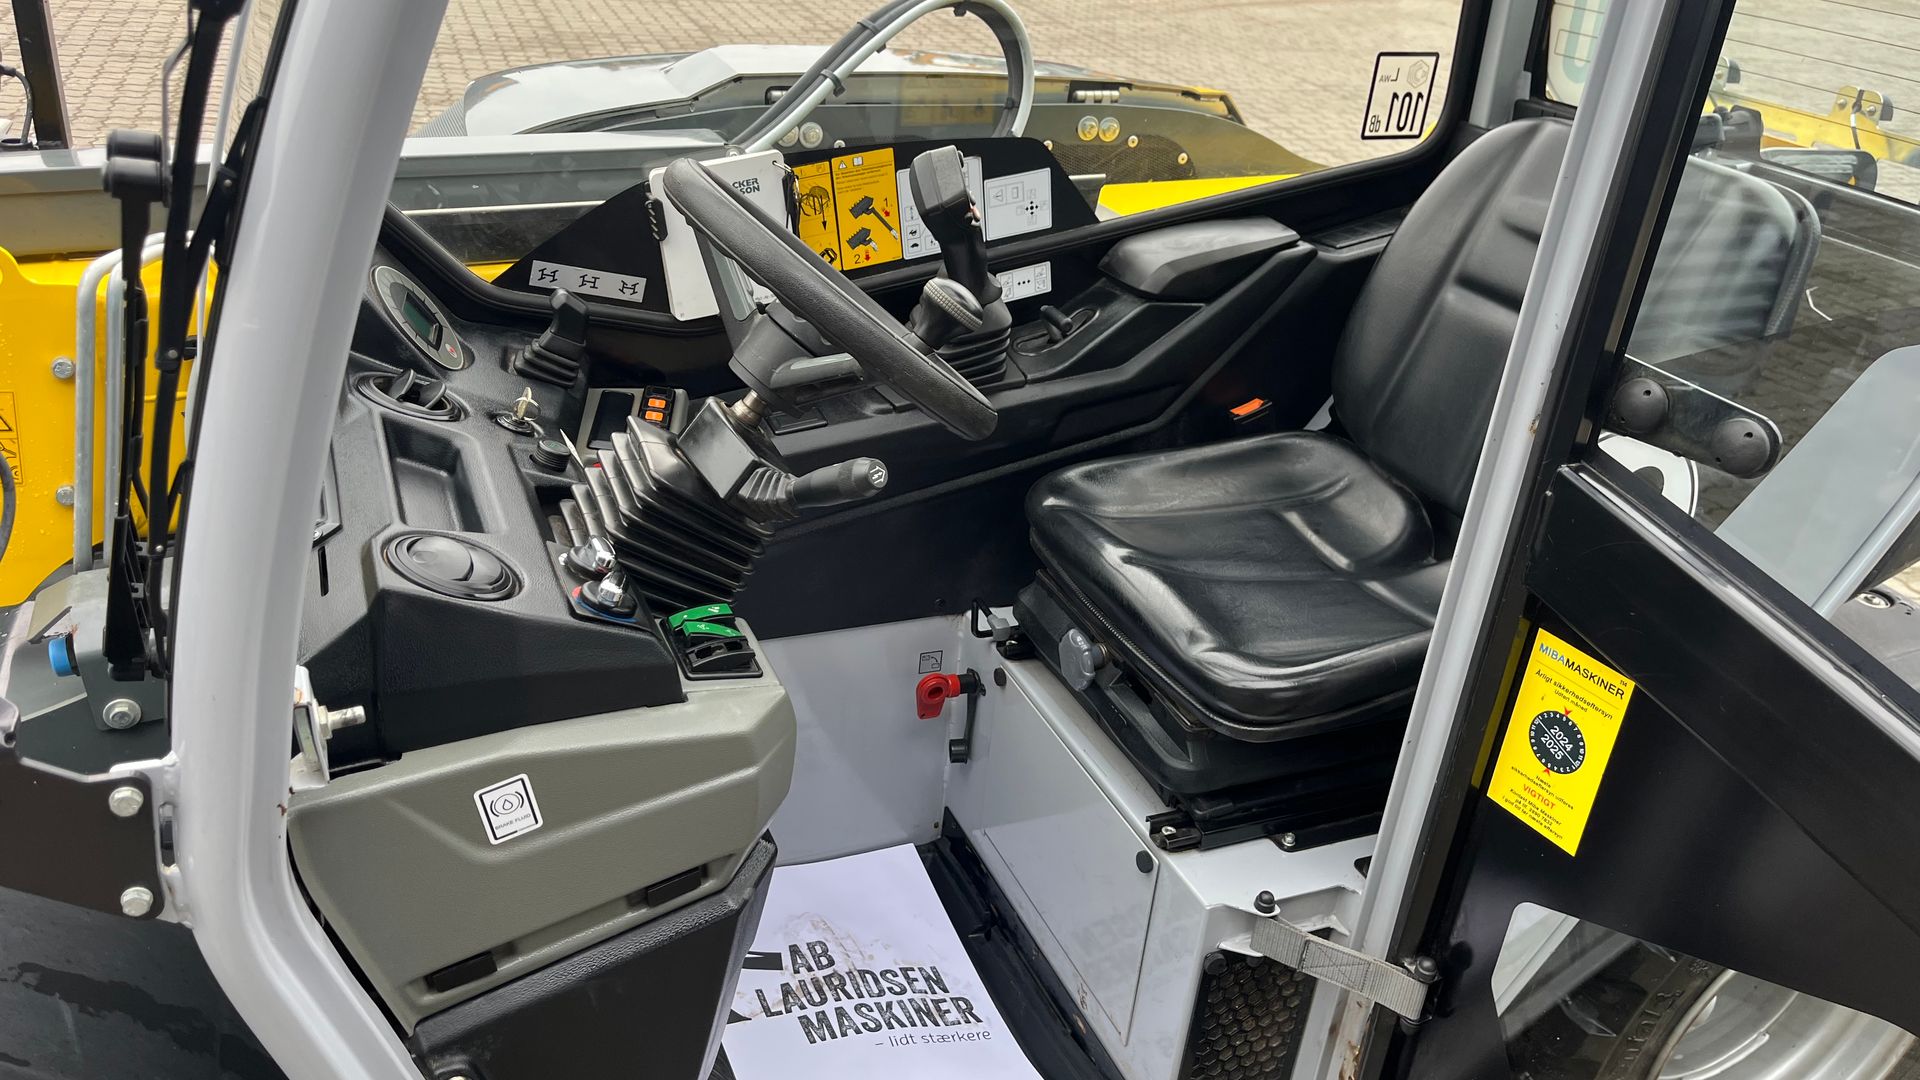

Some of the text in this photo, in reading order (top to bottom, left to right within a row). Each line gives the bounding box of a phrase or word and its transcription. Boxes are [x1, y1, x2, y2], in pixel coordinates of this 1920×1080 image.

[732, 178, 759, 188] CKER
[740, 185, 760, 194] SON
[1540, 643, 1625, 700] MIBAMASKINER
[1536, 669, 1613, 720] Årligt sikkerhedseftersyn
[1540, 734, 1564, 760] 2025
[1550, 725, 1573, 751] 2024
[1522, 784, 1556, 810] VIGTIGT
[788, 940, 836, 975] AB
[755, 965, 950, 1018] LAURIDSEN
[798, 996, 983, 1045] MASKINER
[889, 1034, 916, 1048] lidt
[921, 1029, 992, 1044] stærkere
